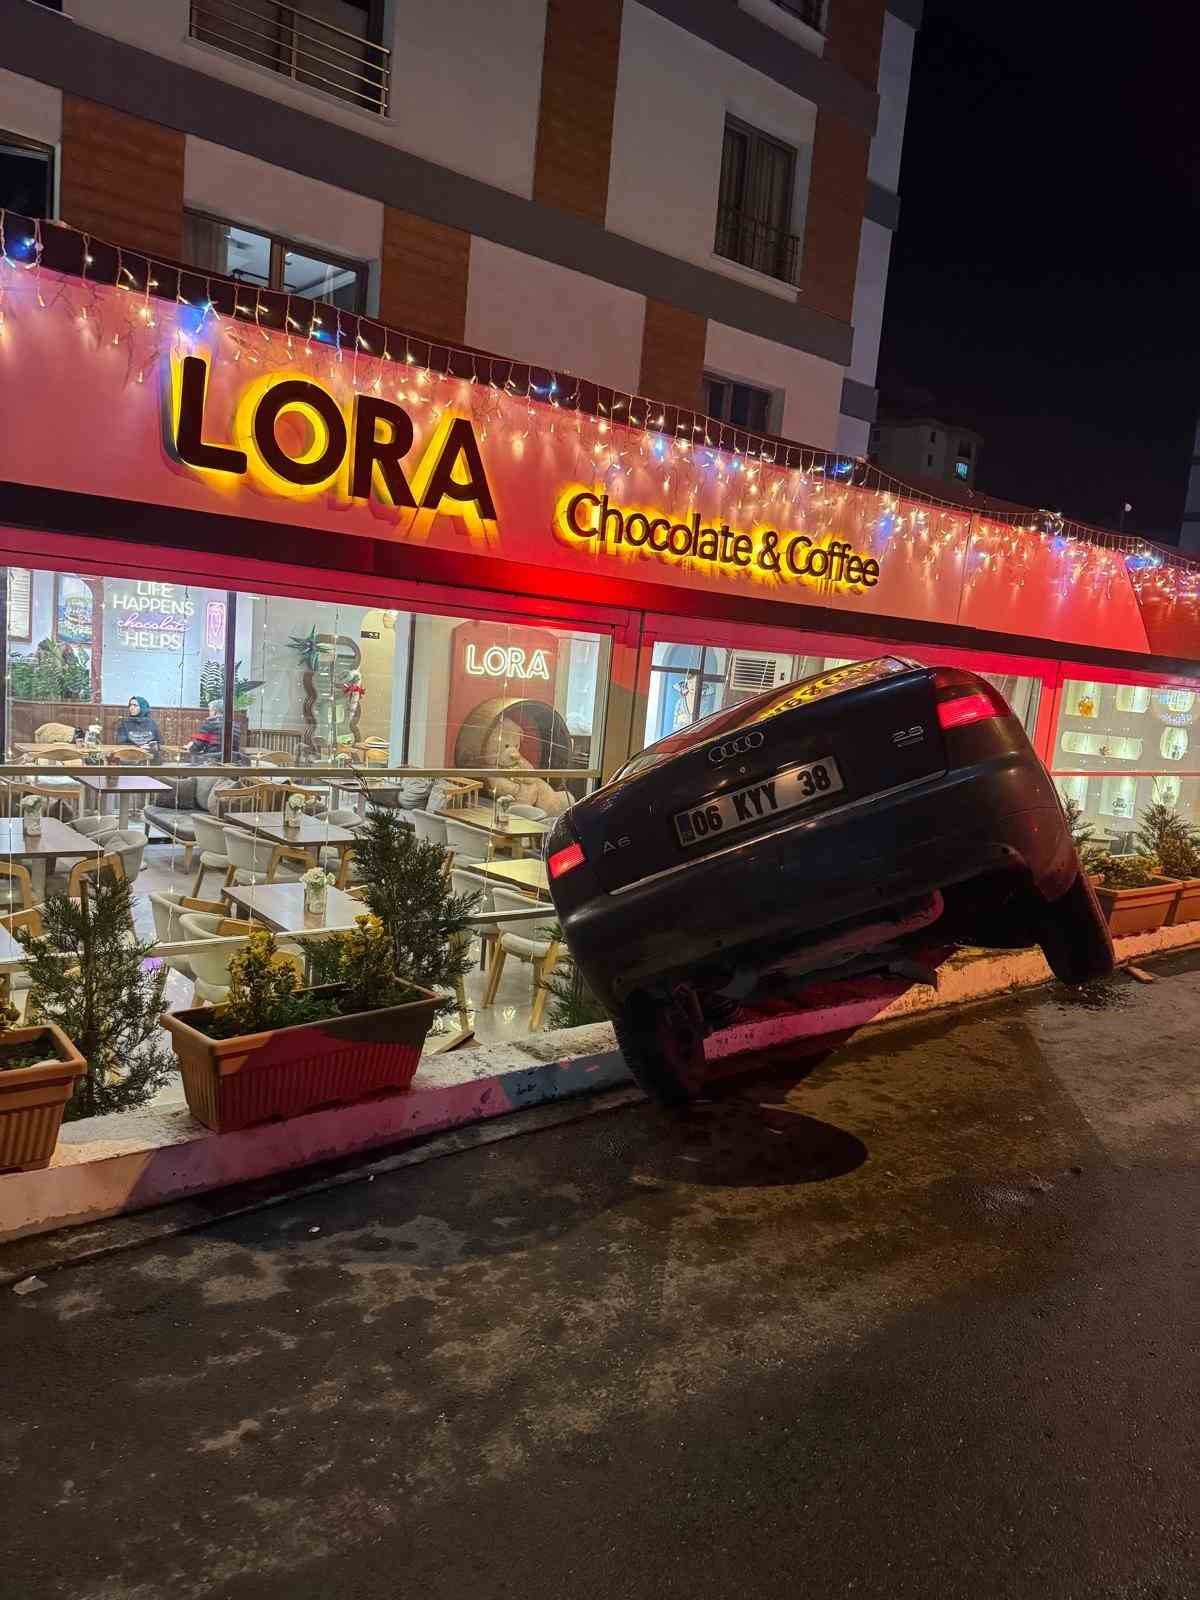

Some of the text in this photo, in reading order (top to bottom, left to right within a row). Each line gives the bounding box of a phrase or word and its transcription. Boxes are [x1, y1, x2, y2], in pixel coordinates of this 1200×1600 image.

[174, 354, 498, 522] LORA
[566, 491, 880, 587] Chocolate & Coffee
[136, 581, 175, 598] LIFE
[113, 594, 195, 616] HAPPENS
[124, 630, 181, 649] HELPS
[465, 643, 550, 680] LORA
[692, 805, 723, 835] 06
[732, 781, 778, 822] KYY
[796, 764, 831, 796] 38
[603, 836, 631, 856] A6
